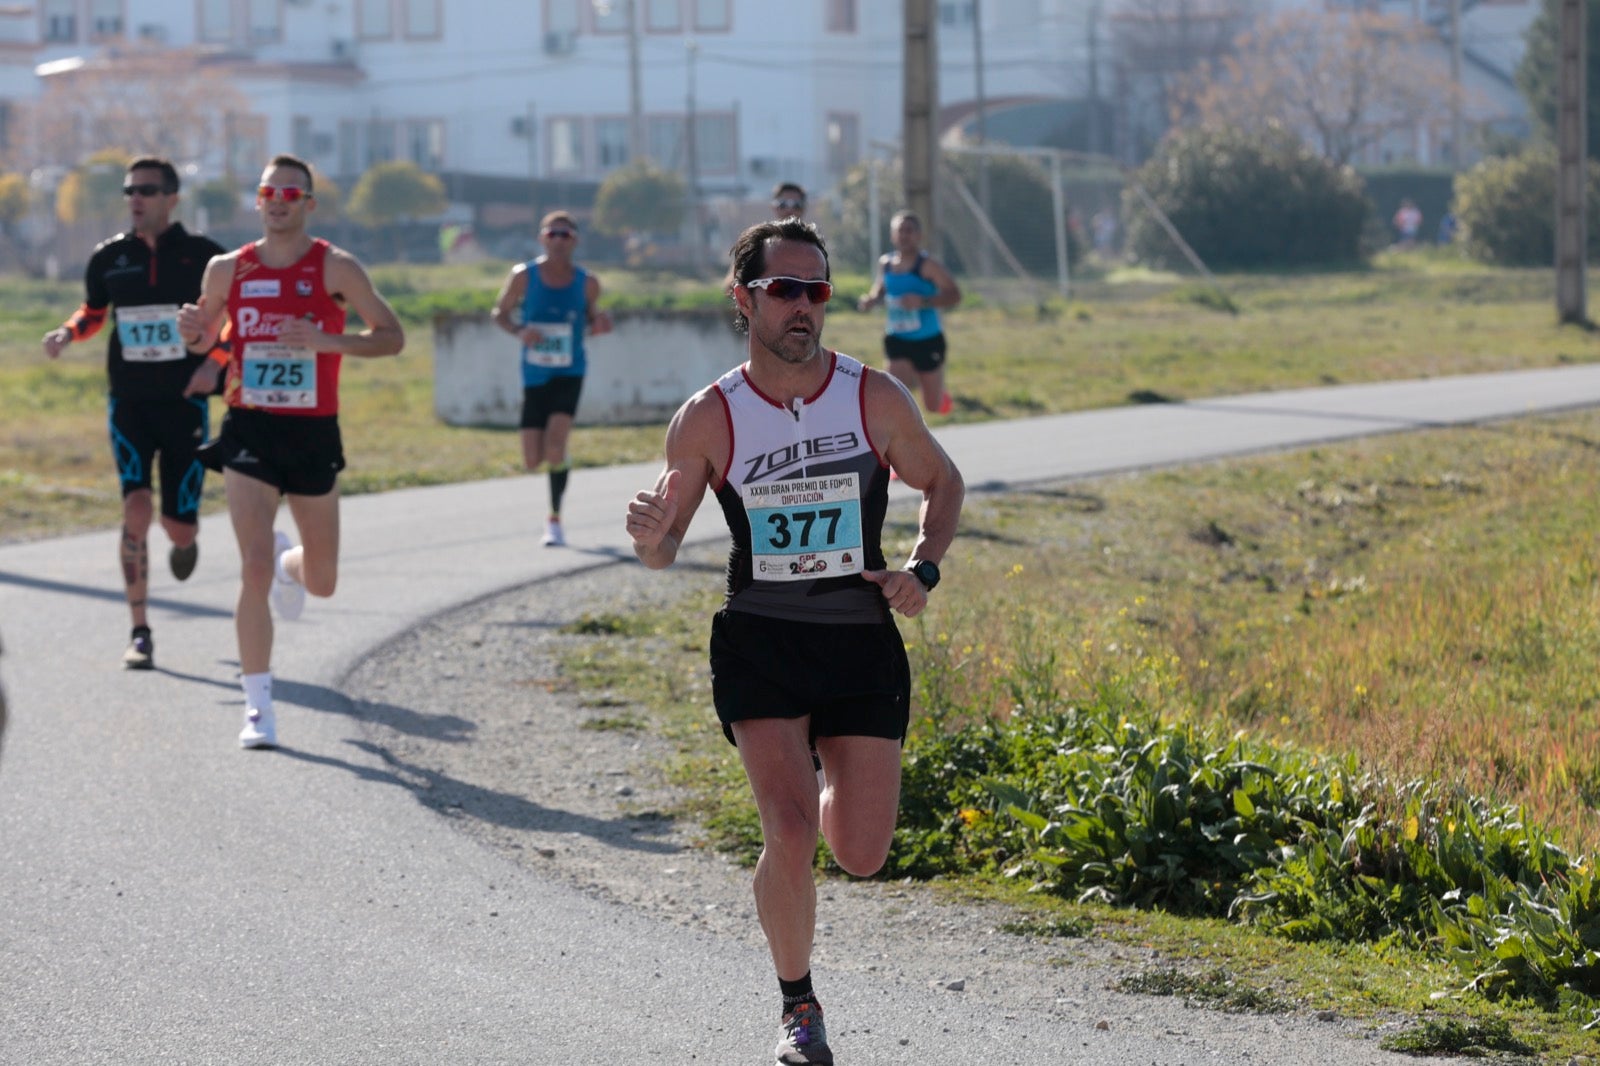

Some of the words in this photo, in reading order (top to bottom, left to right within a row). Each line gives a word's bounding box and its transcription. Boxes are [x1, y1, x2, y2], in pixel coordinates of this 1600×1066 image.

[129, 323, 171, 343] 178
[255, 363, 303, 386] 725
[771, 483, 790, 496] GRAN
[792, 480, 818, 493] PREMIO
[820, 480, 828, 490] DE
[781, 491, 824, 505] DIPUTACIÓN
[767, 508, 842, 549] 377
